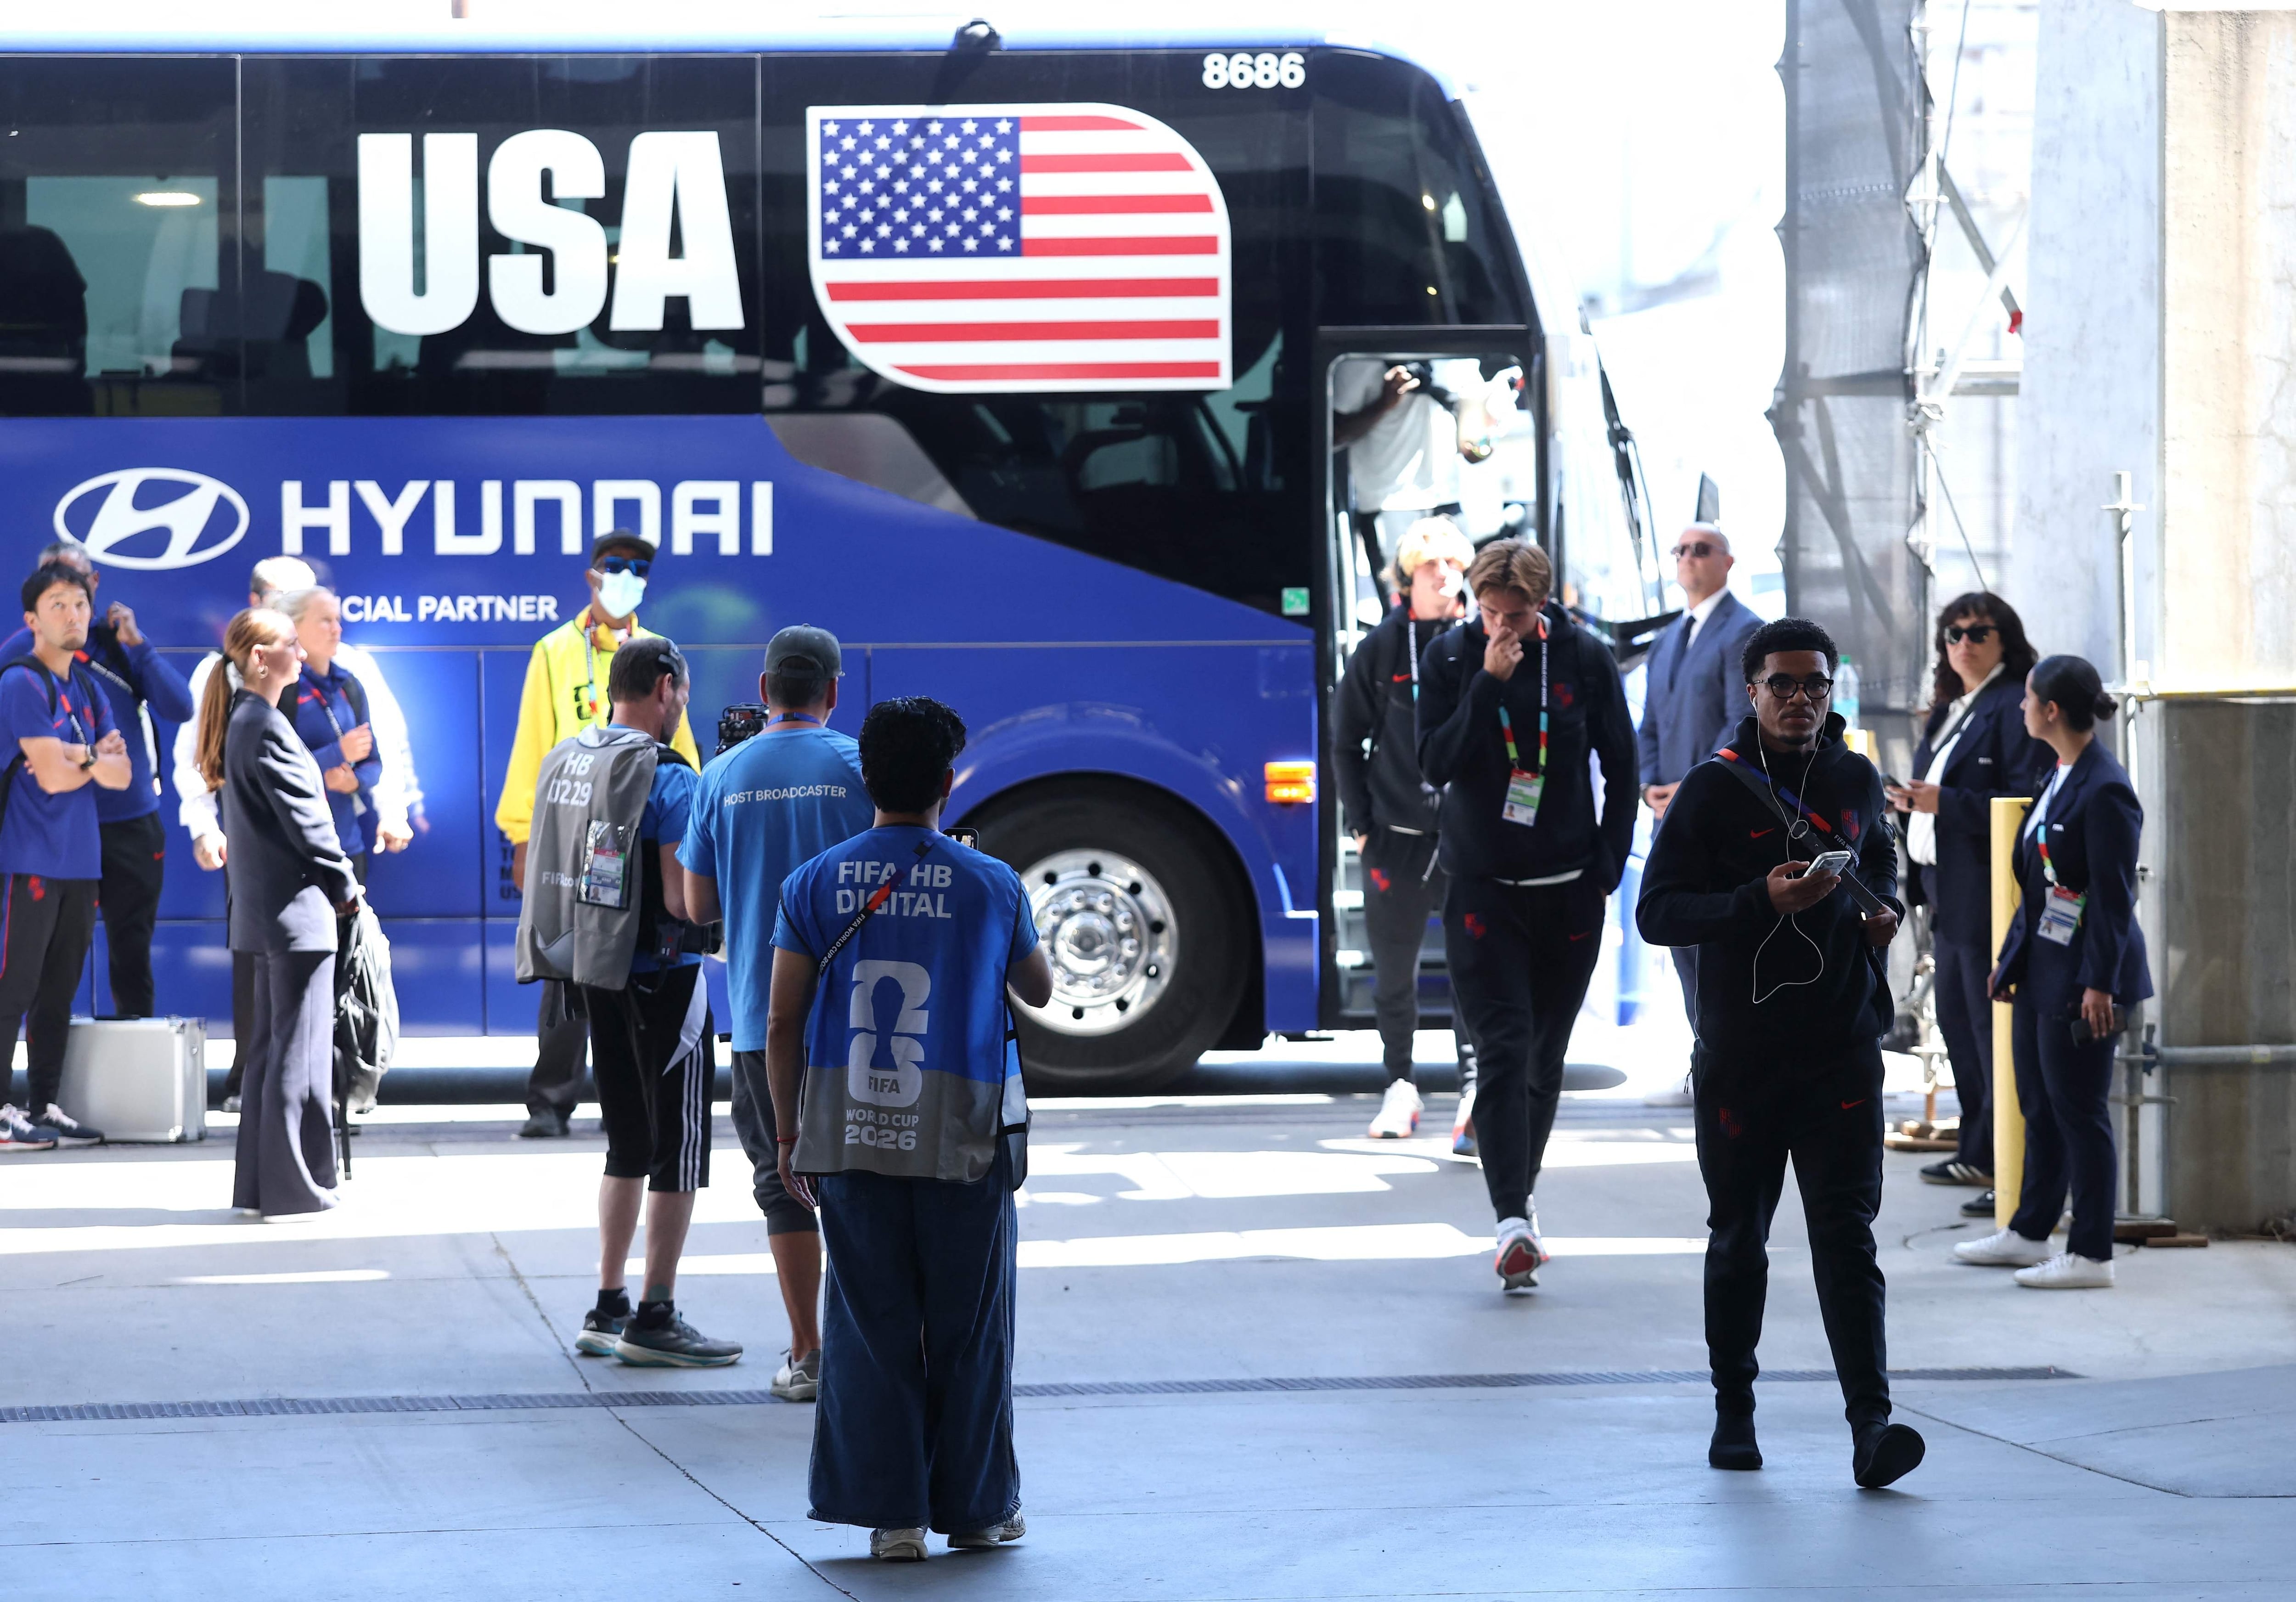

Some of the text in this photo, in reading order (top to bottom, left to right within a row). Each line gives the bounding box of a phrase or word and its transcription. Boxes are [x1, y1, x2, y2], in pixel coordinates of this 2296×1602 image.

[1203, 53, 1306, 89] 8686
[357, 129, 745, 336] USA
[281, 480, 773, 556] HYUNDAI
[418, 595, 559, 622] PARTNER
[564, 752, 595, 776] HB
[724, 784, 846, 807] HOST BROADCASTER
[1834, 834, 1846, 846] FIFA
[838, 861, 952, 887] FIFA HB
[852, 913, 866, 927] FIFA
[836, 926, 855, 947] WORLD
[827, 947, 838, 959] CUP
[869, 1075, 901, 1094] FIFA
[846, 1109, 919, 1127] WORLD CUP
[845, 1124, 917, 1151] 2026
